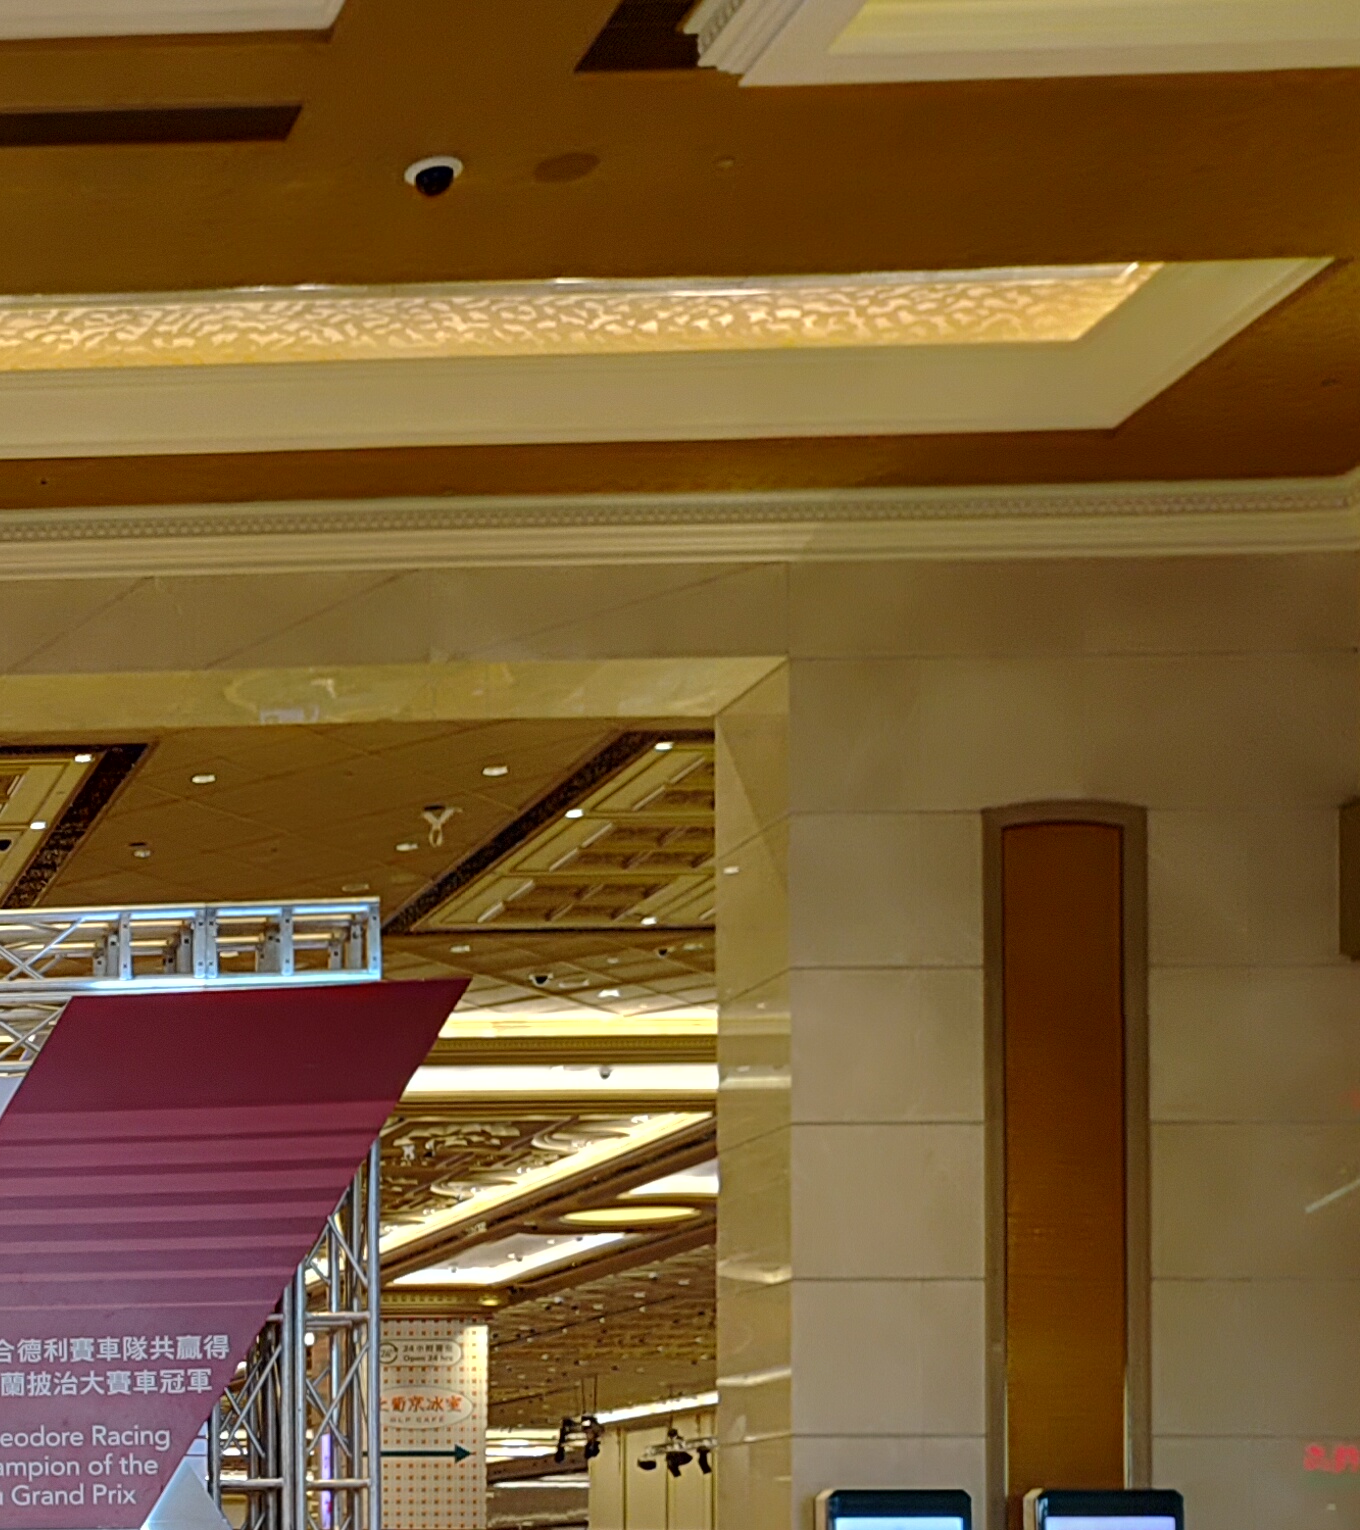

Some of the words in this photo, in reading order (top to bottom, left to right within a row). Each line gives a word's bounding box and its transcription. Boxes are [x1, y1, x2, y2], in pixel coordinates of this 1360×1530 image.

[92, 1427, 170, 1451] Racing
[88, 1454, 114, 1476] of
[118, 1453, 158, 1475] the
[11, 1483, 86, 1507] Grand
[92, 1483, 137, 1505] Prix
